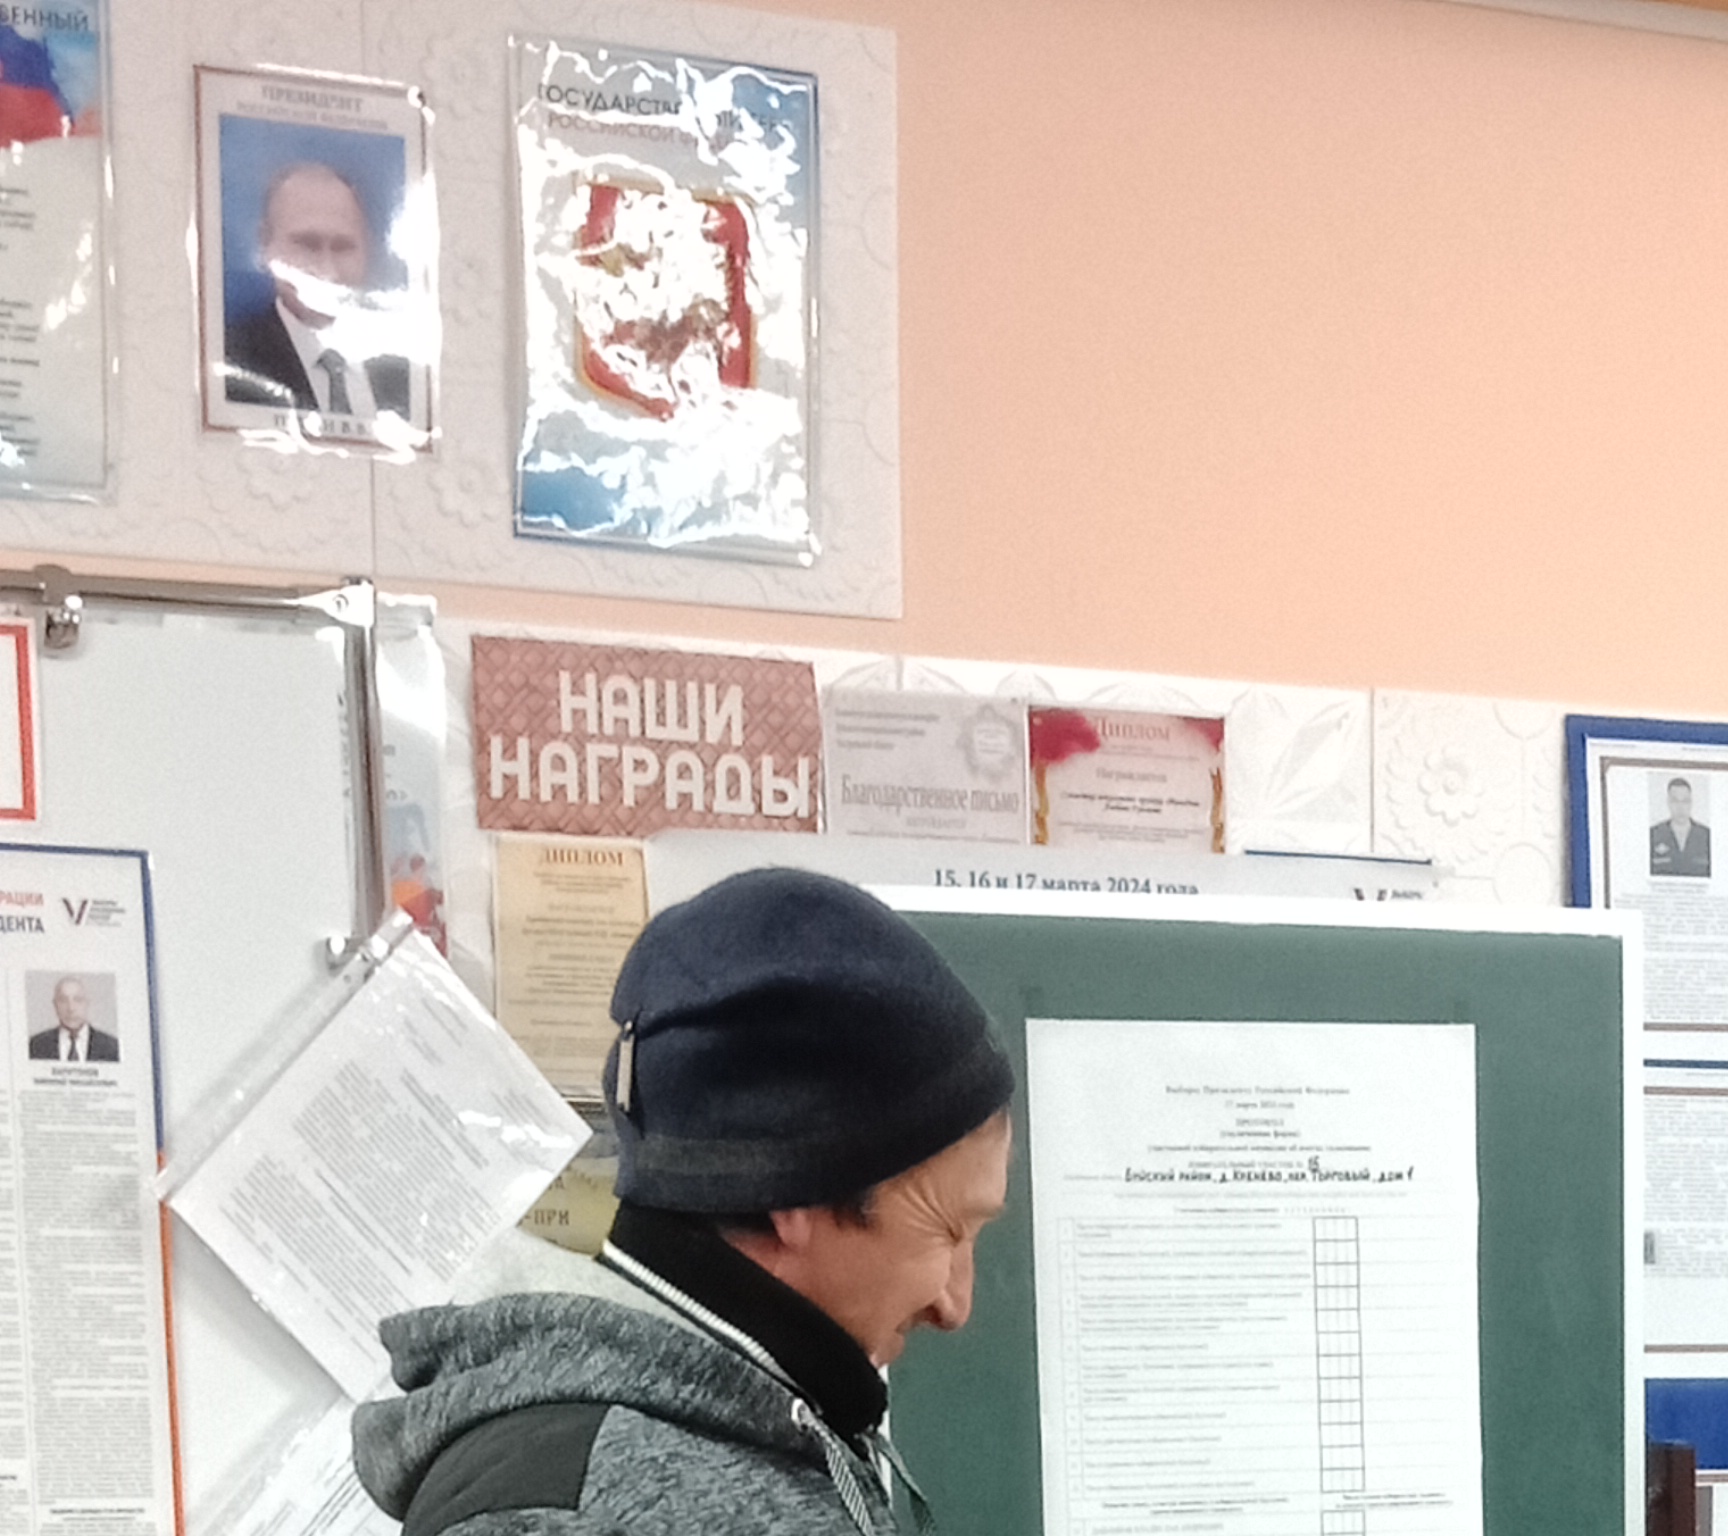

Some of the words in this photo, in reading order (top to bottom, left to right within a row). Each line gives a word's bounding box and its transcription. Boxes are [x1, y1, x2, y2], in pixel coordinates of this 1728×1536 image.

[559, 669, 744, 747] НАШИ
[489, 734, 809, 818] НАГРАДЫ
[540, 848, 623, 866] ДИПЛОМ
[968, 870, 991, 889] 16
[996, 875, 1009, 889] и
[1016, 873, 1037, 890] 17
[1106, 876, 1152, 894] 2024
